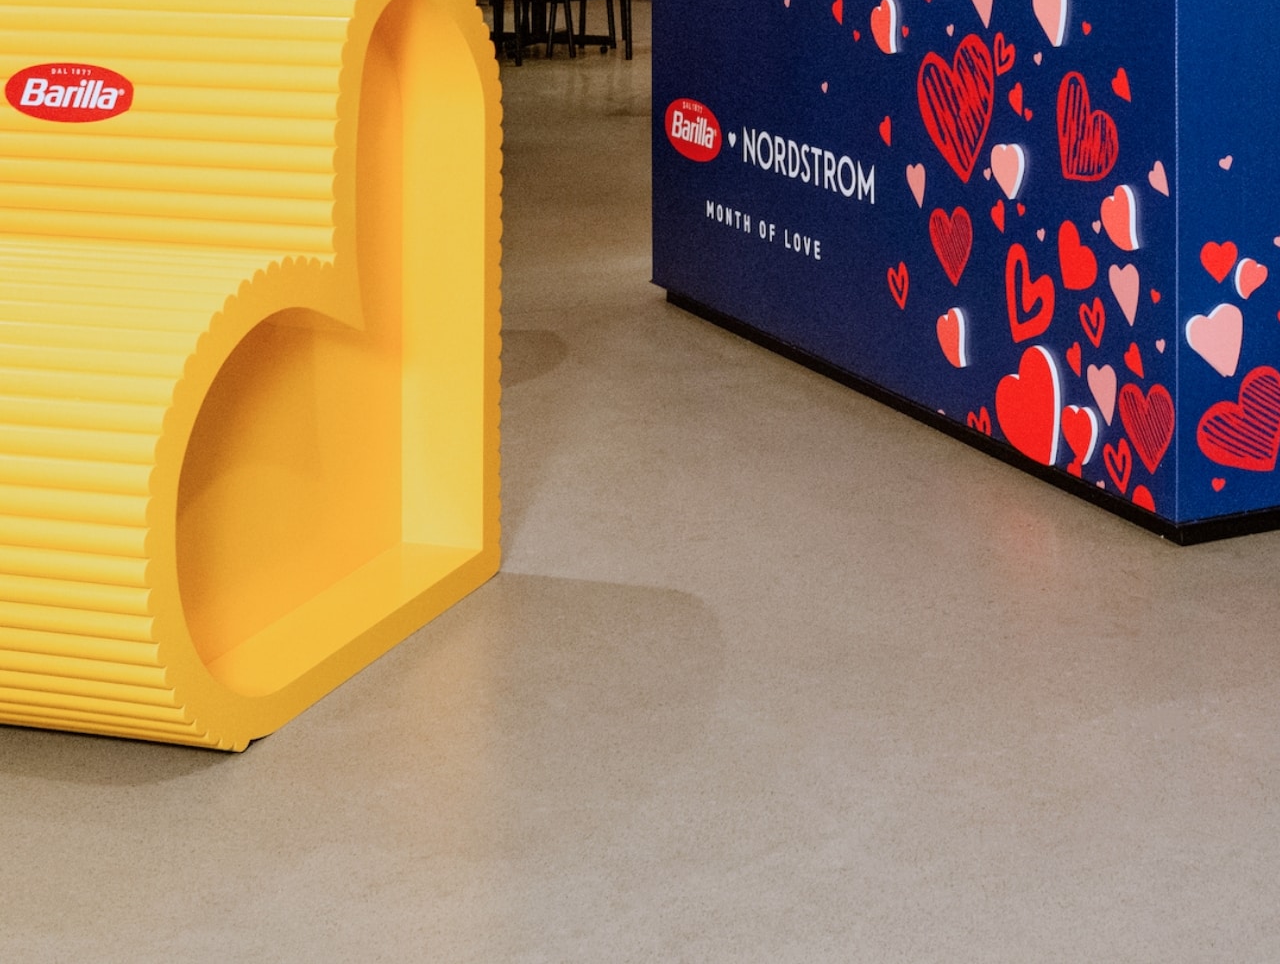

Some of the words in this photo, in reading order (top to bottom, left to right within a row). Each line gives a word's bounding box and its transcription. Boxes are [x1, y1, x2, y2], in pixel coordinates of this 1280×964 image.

[20, 77, 118, 110] Barilla
[671, 110, 714, 149] Barilla
[743, 126, 875, 205] NORDSTROM
[706, 200, 751, 233] MONTH
[759, 220, 776, 242] OF
[784, 229, 821, 261] LOVE
